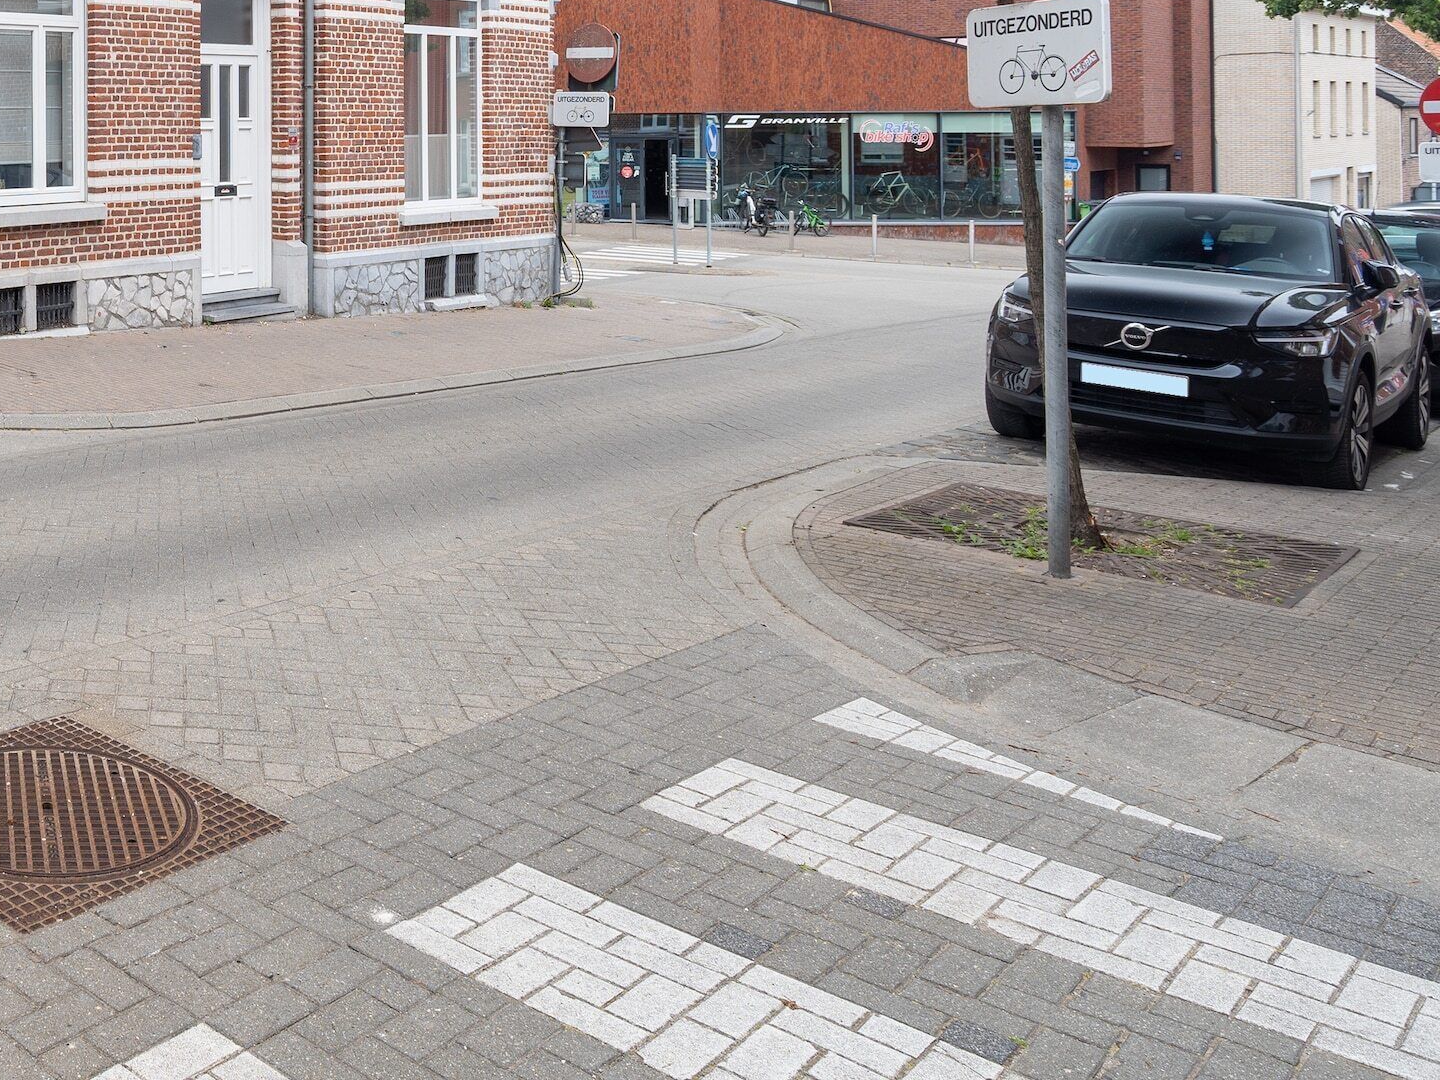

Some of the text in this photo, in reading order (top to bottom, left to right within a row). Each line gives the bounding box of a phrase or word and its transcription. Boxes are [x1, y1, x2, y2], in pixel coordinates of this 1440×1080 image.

[973, 8, 1093, 38] UITGEZONDERD
[760, 117, 850, 125] GRANVILLE
[865, 130, 929, 145] bike shop
